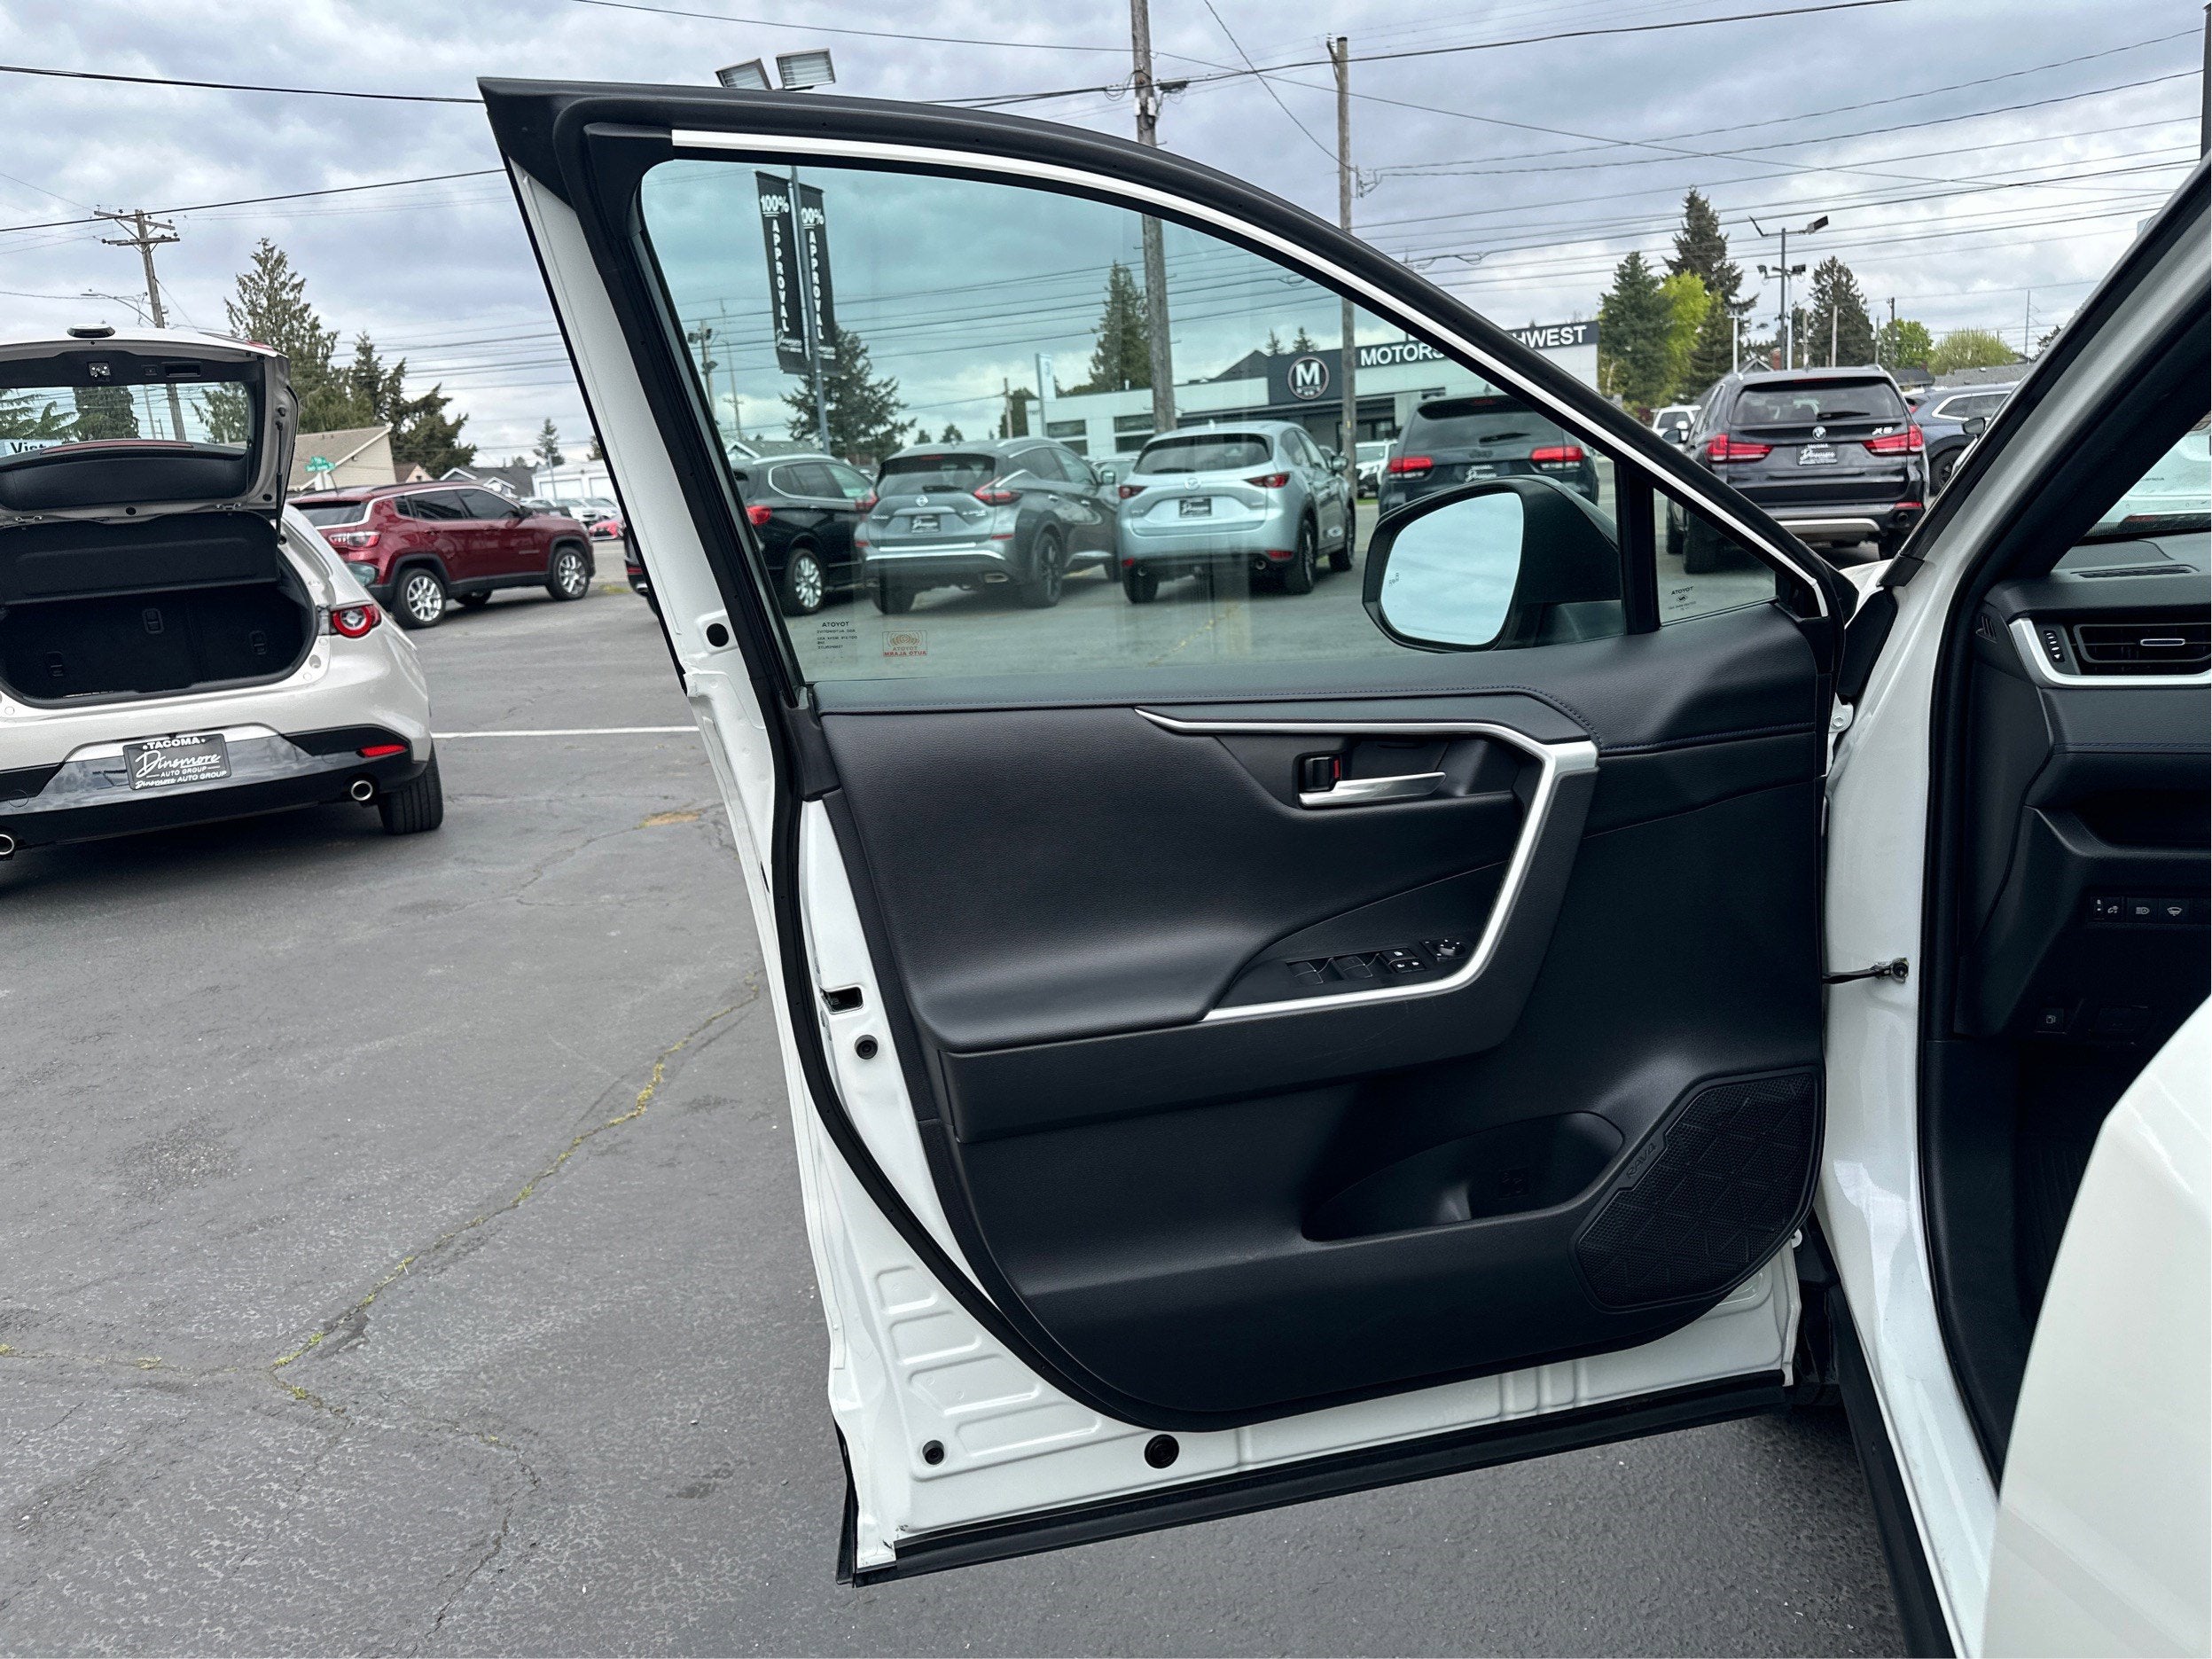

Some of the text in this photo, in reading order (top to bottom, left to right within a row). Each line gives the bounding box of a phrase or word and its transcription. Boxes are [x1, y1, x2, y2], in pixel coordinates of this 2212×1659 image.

[761, 194, 789, 213] 100%
[801, 207, 825, 225] 00%
[772, 219, 790, 332] APPROVAL
[809, 231, 825, 340] APPROVAL
[1295, 362, 1321, 387] M
[146, 737, 200, 750] TACOMA
[160, 765, 207, 778] AUTO GROUP
[176, 773, 199, 783] AUTO
[199, 770, 228, 780] GROUP
